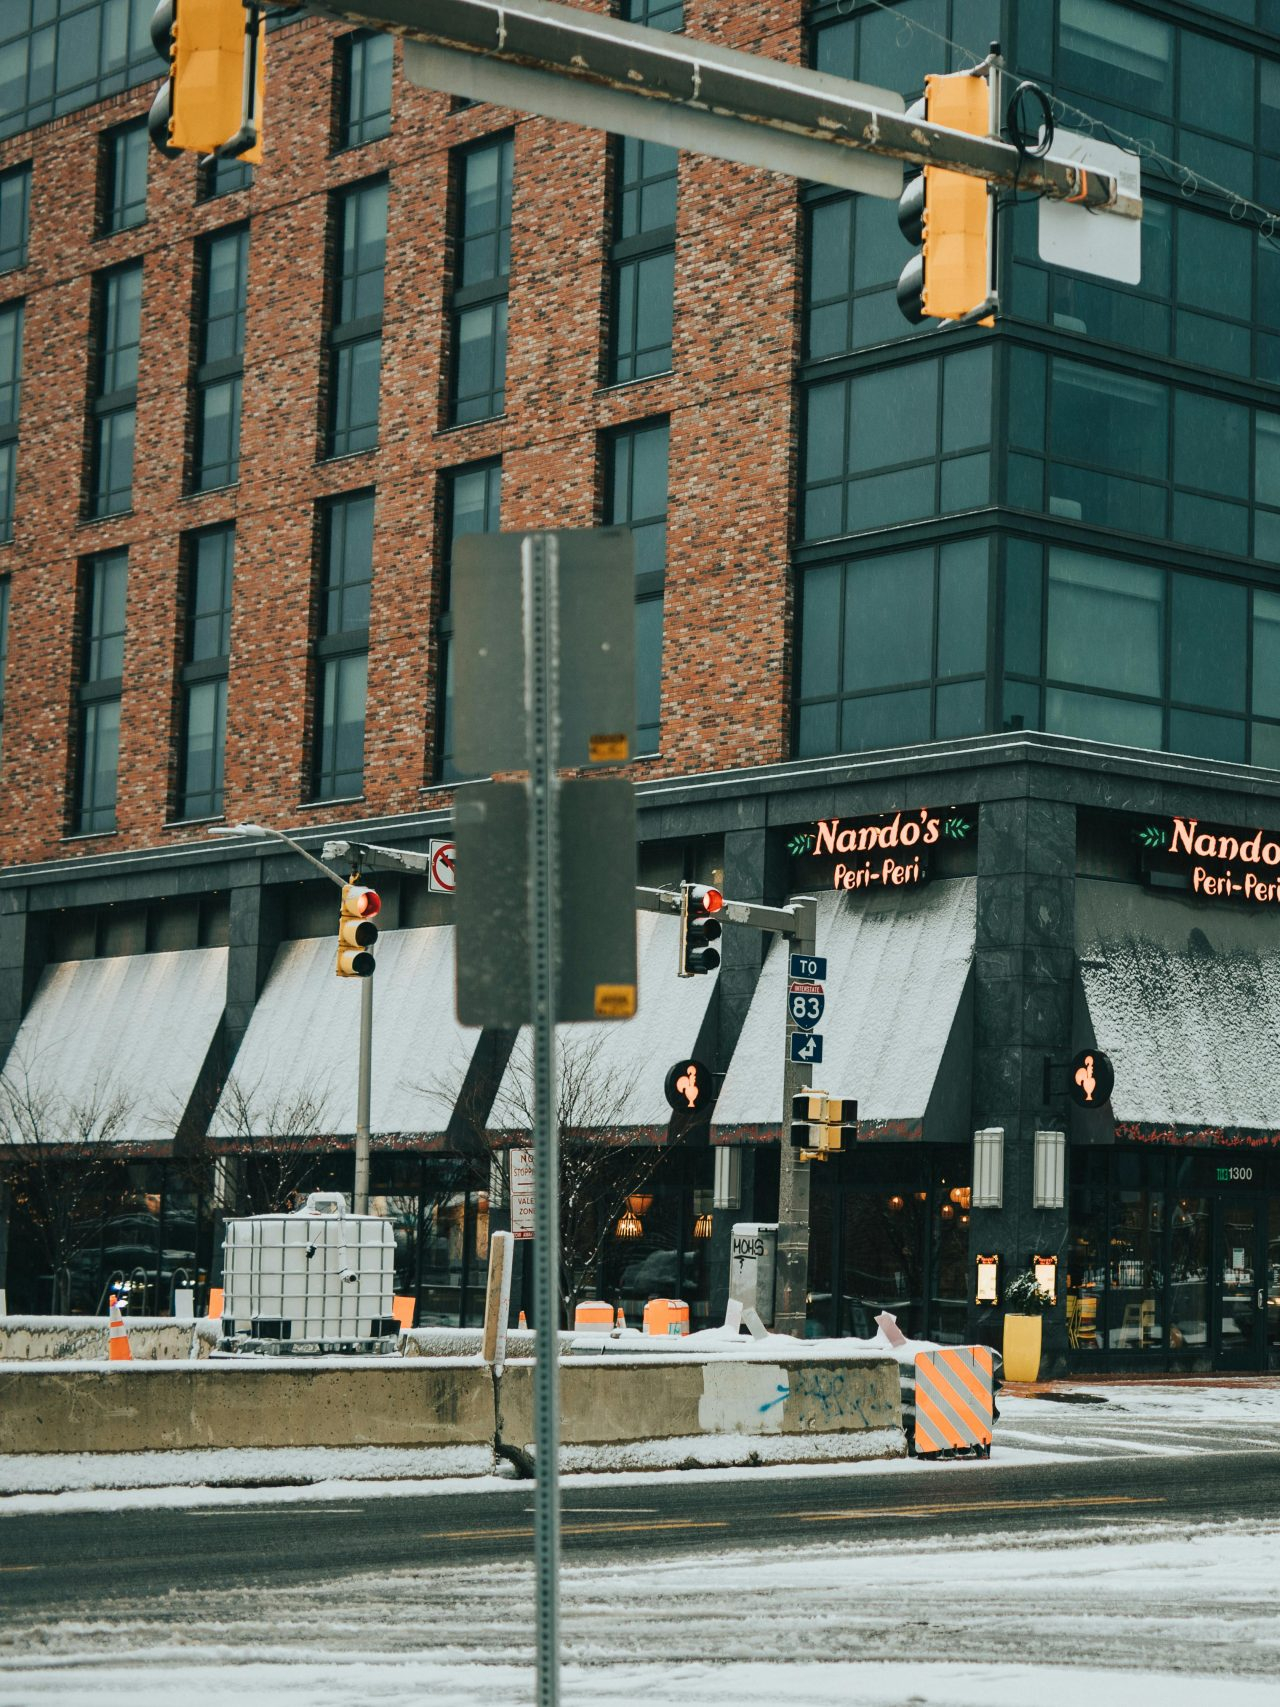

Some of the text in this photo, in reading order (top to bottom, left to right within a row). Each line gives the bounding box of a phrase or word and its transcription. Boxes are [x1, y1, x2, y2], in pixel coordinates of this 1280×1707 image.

[812, 809, 940, 856] Nando's
[834, 856, 919, 890] Peri-Peri
[800, 960, 817, 974] TO
[794, 985, 820, 993] INTERSTATE
[793, 996, 820, 1019] 83
[513, 1168, 535, 1177] STOPPI
[1229, 1167, 1253, 1180] 1300
